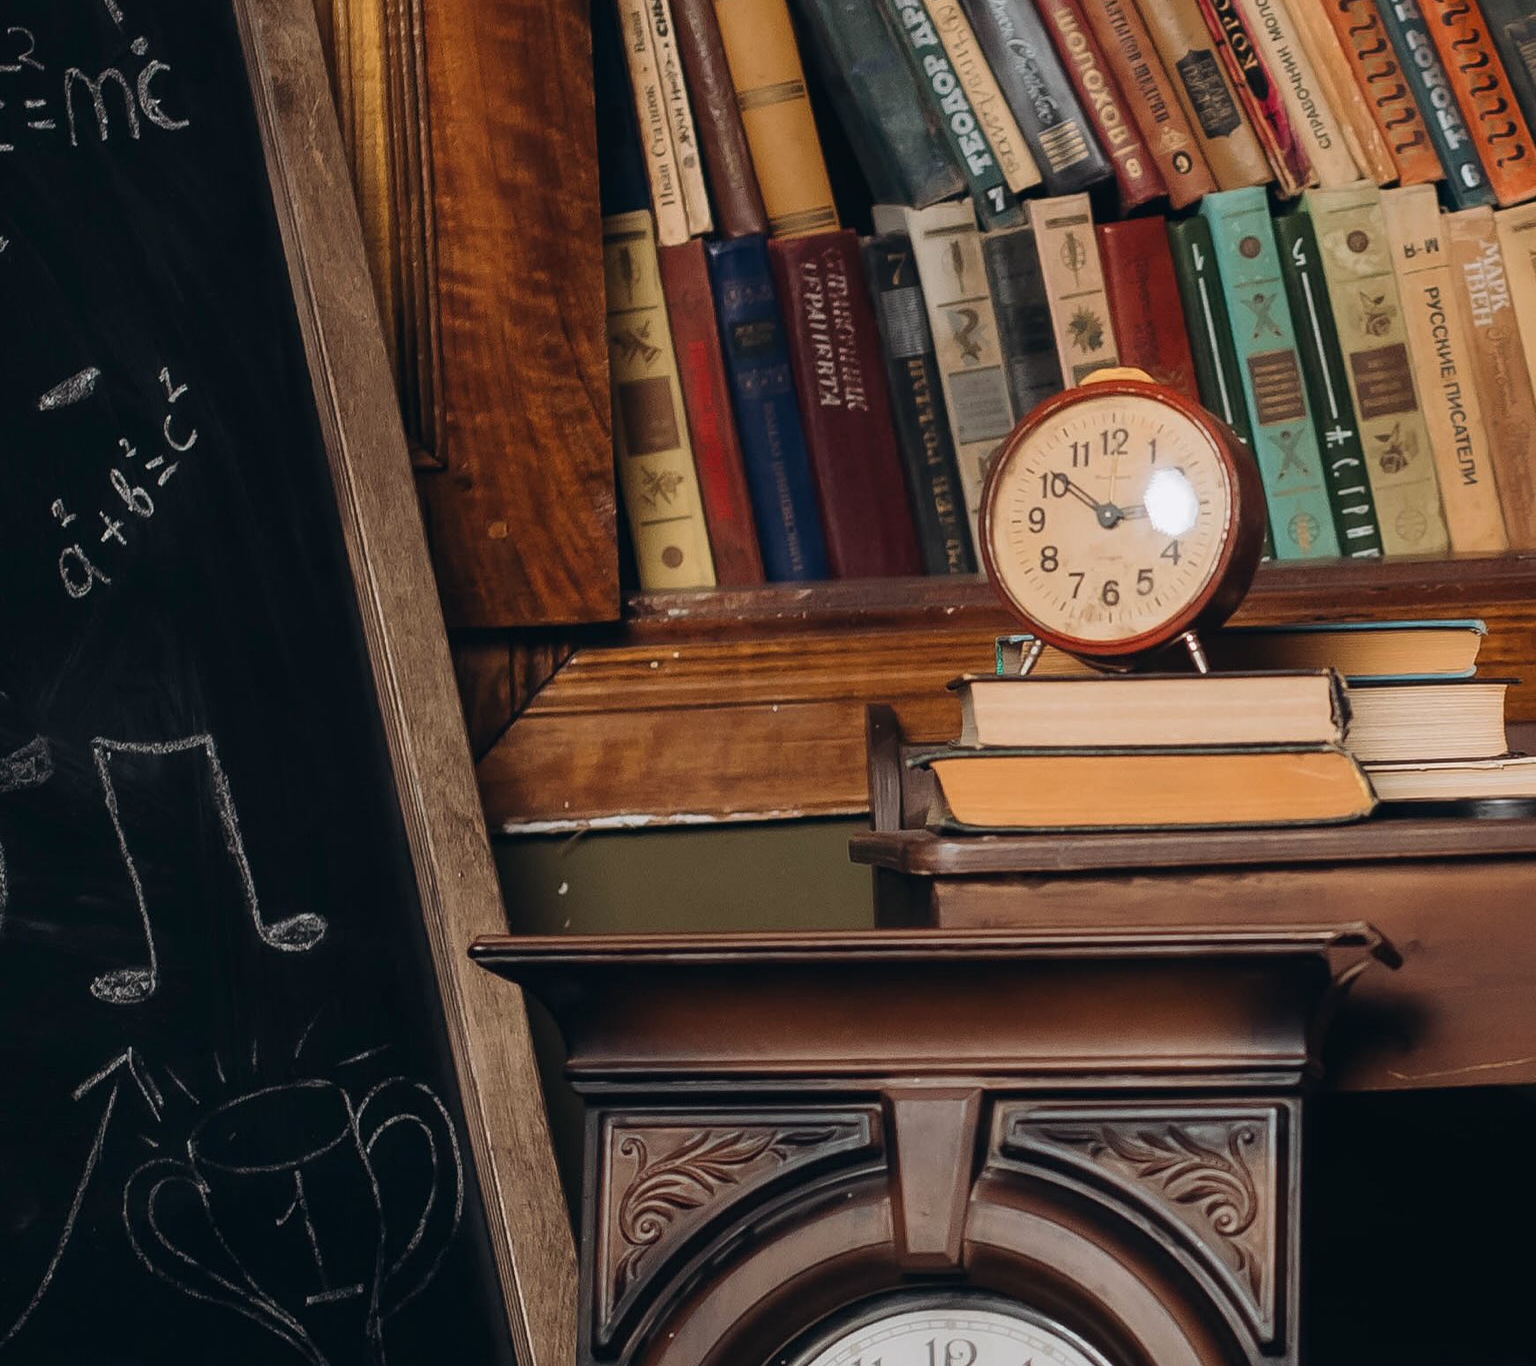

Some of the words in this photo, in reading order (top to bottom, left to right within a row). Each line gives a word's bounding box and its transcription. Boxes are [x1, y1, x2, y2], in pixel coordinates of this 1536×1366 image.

[1050, 4, 1132, 145] ШОЛОХОВ
[1400, 25, 1471, 151] ТЕОДОР
[1273, 45, 1336, 150] СПРАВОЧНИК
[640, 84, 667, 158] Стаднюк
[918, 49, 996, 177] ТЕОДОР
[653, 162, 675, 206] Иван
[1460, 163, 1480, 188] 6
[987, 186, 1004, 212] 7
[887, 253, 906, 285] 7
[1479, 238, 1510, 312] МАРК
[1461, 259, 1495, 328] ТВЕН
[1422, 286, 1457, 379] РУССКИЕ
[1442, 381, 1480, 486] ПИСАТЕЛИ
[1069, 441, 1090, 467] 11
[1100, 428, 1129, 456] 12
[1147, 438, 1157, 464] 1
[1330, 454, 1361, 477] С.
[1039, 472, 1070, 499] 10
[1028, 507, 1046, 533] 9
[1040, 545, 1059, 573] 8
[1160, 539, 1182, 566] 4
[1068, 572, 1086, 599] 7
[1101, 580, 1121, 607] 6
[1136, 568, 1155, 597] 5
